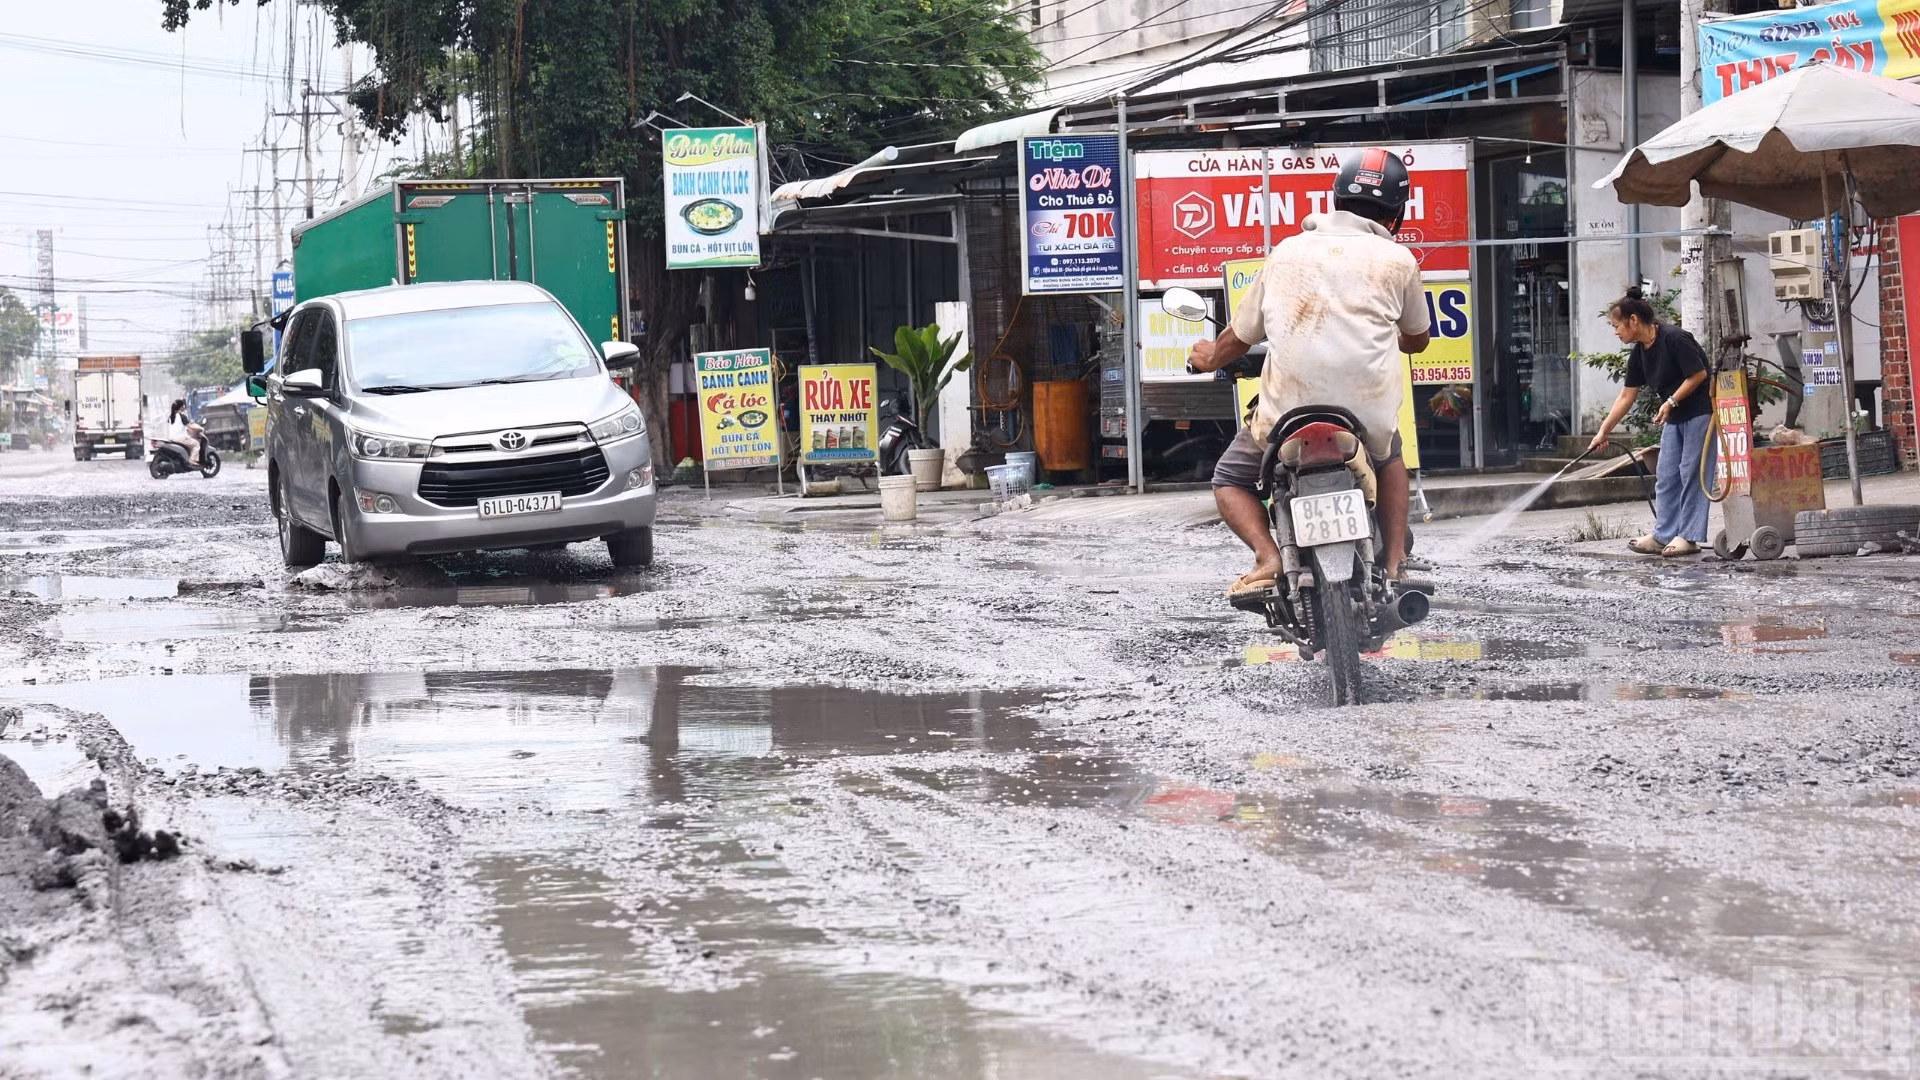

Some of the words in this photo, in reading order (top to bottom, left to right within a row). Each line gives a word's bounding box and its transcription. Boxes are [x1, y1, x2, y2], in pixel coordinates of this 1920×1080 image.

[1760, 22, 1823, 43] BÌNH
[668, 133, 709, 158] Bảo
[712, 131, 750, 157] Hân
[1029, 140, 1083, 161] Tiệm
[1188, 154, 1221, 172] CỬA
[1282, 157, 1315, 170] GAS
[1320, 153, 1340, 169] VÀ
[698, 171, 719, 195] CANH
[1030, 167, 1081, 191] Nhà
[1081, 165, 1112, 189] Di
[1039, 195, 1063, 206] Cho
[1066, 194, 1094, 205] Thuê
[1098, 190, 1114, 204] Đồ
[1222, 185, 1295, 228] VĂN
[1064, 212, 1115, 238] 70K
[1172, 244, 1207, 255] Chuyên
[1210, 246, 1233, 256] cung
[1236, 242, 1253, 255] cấp
[1172, 263, 1194, 274] Cầm
[1196, 263, 1209, 273] đồ
[705, 356, 731, 370] Bảo
[737, 370, 768, 386] CANH
[1412, 367, 1471, 381] 63.954.355
[805, 370, 844, 410] RỬA
[849, 380, 871, 409] XE
[707, 392, 735, 414] Cá
[740, 393, 767, 408] lóc
[810, 413, 836, 423] THAY
[840, 411, 868, 422] NHỚT
[1718, 462, 1728, 478] XE
[484, 495, 556, 515] 61LD-043.71
[1303, 495, 1354, 519] 84-K2
[1306, 517, 1357, 541] 2818
